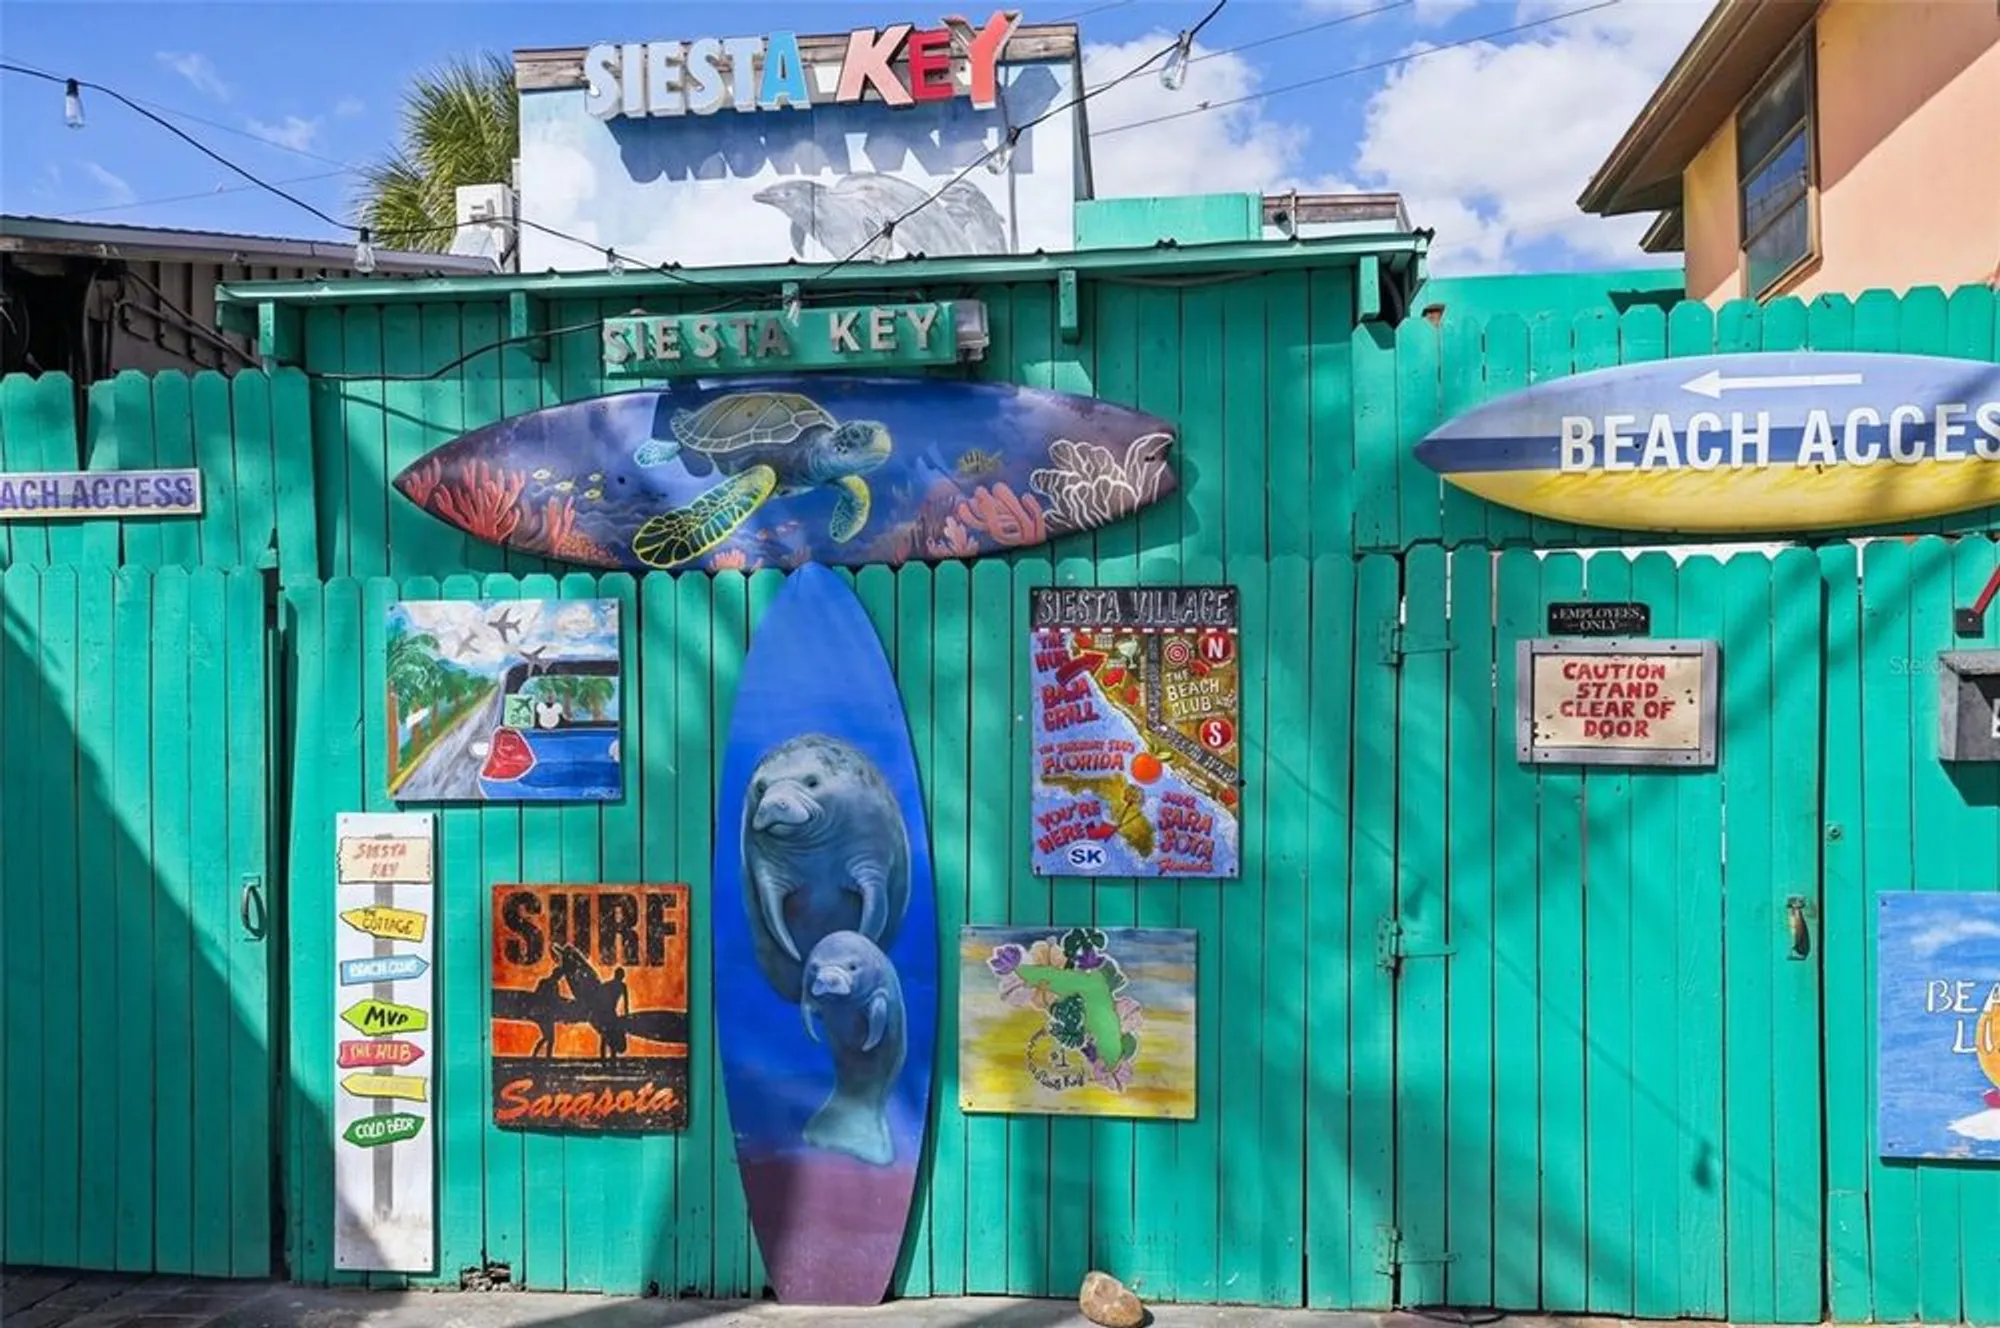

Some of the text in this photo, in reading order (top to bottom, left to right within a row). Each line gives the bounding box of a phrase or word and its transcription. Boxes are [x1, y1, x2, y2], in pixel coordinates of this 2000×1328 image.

[584, 10, 1023, 119] SIESTA KEY
[602, 304, 939, 364] SIESTA KEY
[1561, 411, 1770, 473] BEACH
[70, 477, 195, 509] ACCESS
[1038, 588, 1232, 625] SIESTA VILLAGE
[1560, 607, 1639, 619] EMPLOYEES
[1580, 619, 1616, 630] ONLY
[1208, 637, 1225, 658] N
[1563, 663, 1665, 680] CAUTION
[1166, 678, 1219, 702] BEACH
[1576, 682, 1659, 699] STAND
[1171, 696, 1212, 717] CLUB
[1560, 700, 1676, 720] CLEAR OF
[1208, 722, 1223, 751] S
[1584, 720, 1649, 738] DOOR
[1043, 751, 1124, 774] FLORIDA
[353, 843, 407, 860] SIESTA
[1071, 848, 1102, 865] SK
[370, 862, 398, 878] KEY
[361, 913, 415, 935] COTTAGE
[502, 890, 678, 967] SURF
[364, 1006, 409, 1028] MVP
[375, 1043, 412, 1061] HUB
[497, 1079, 679, 1120] Sarasota
[356, 1117, 416, 1139] COLD BEER
